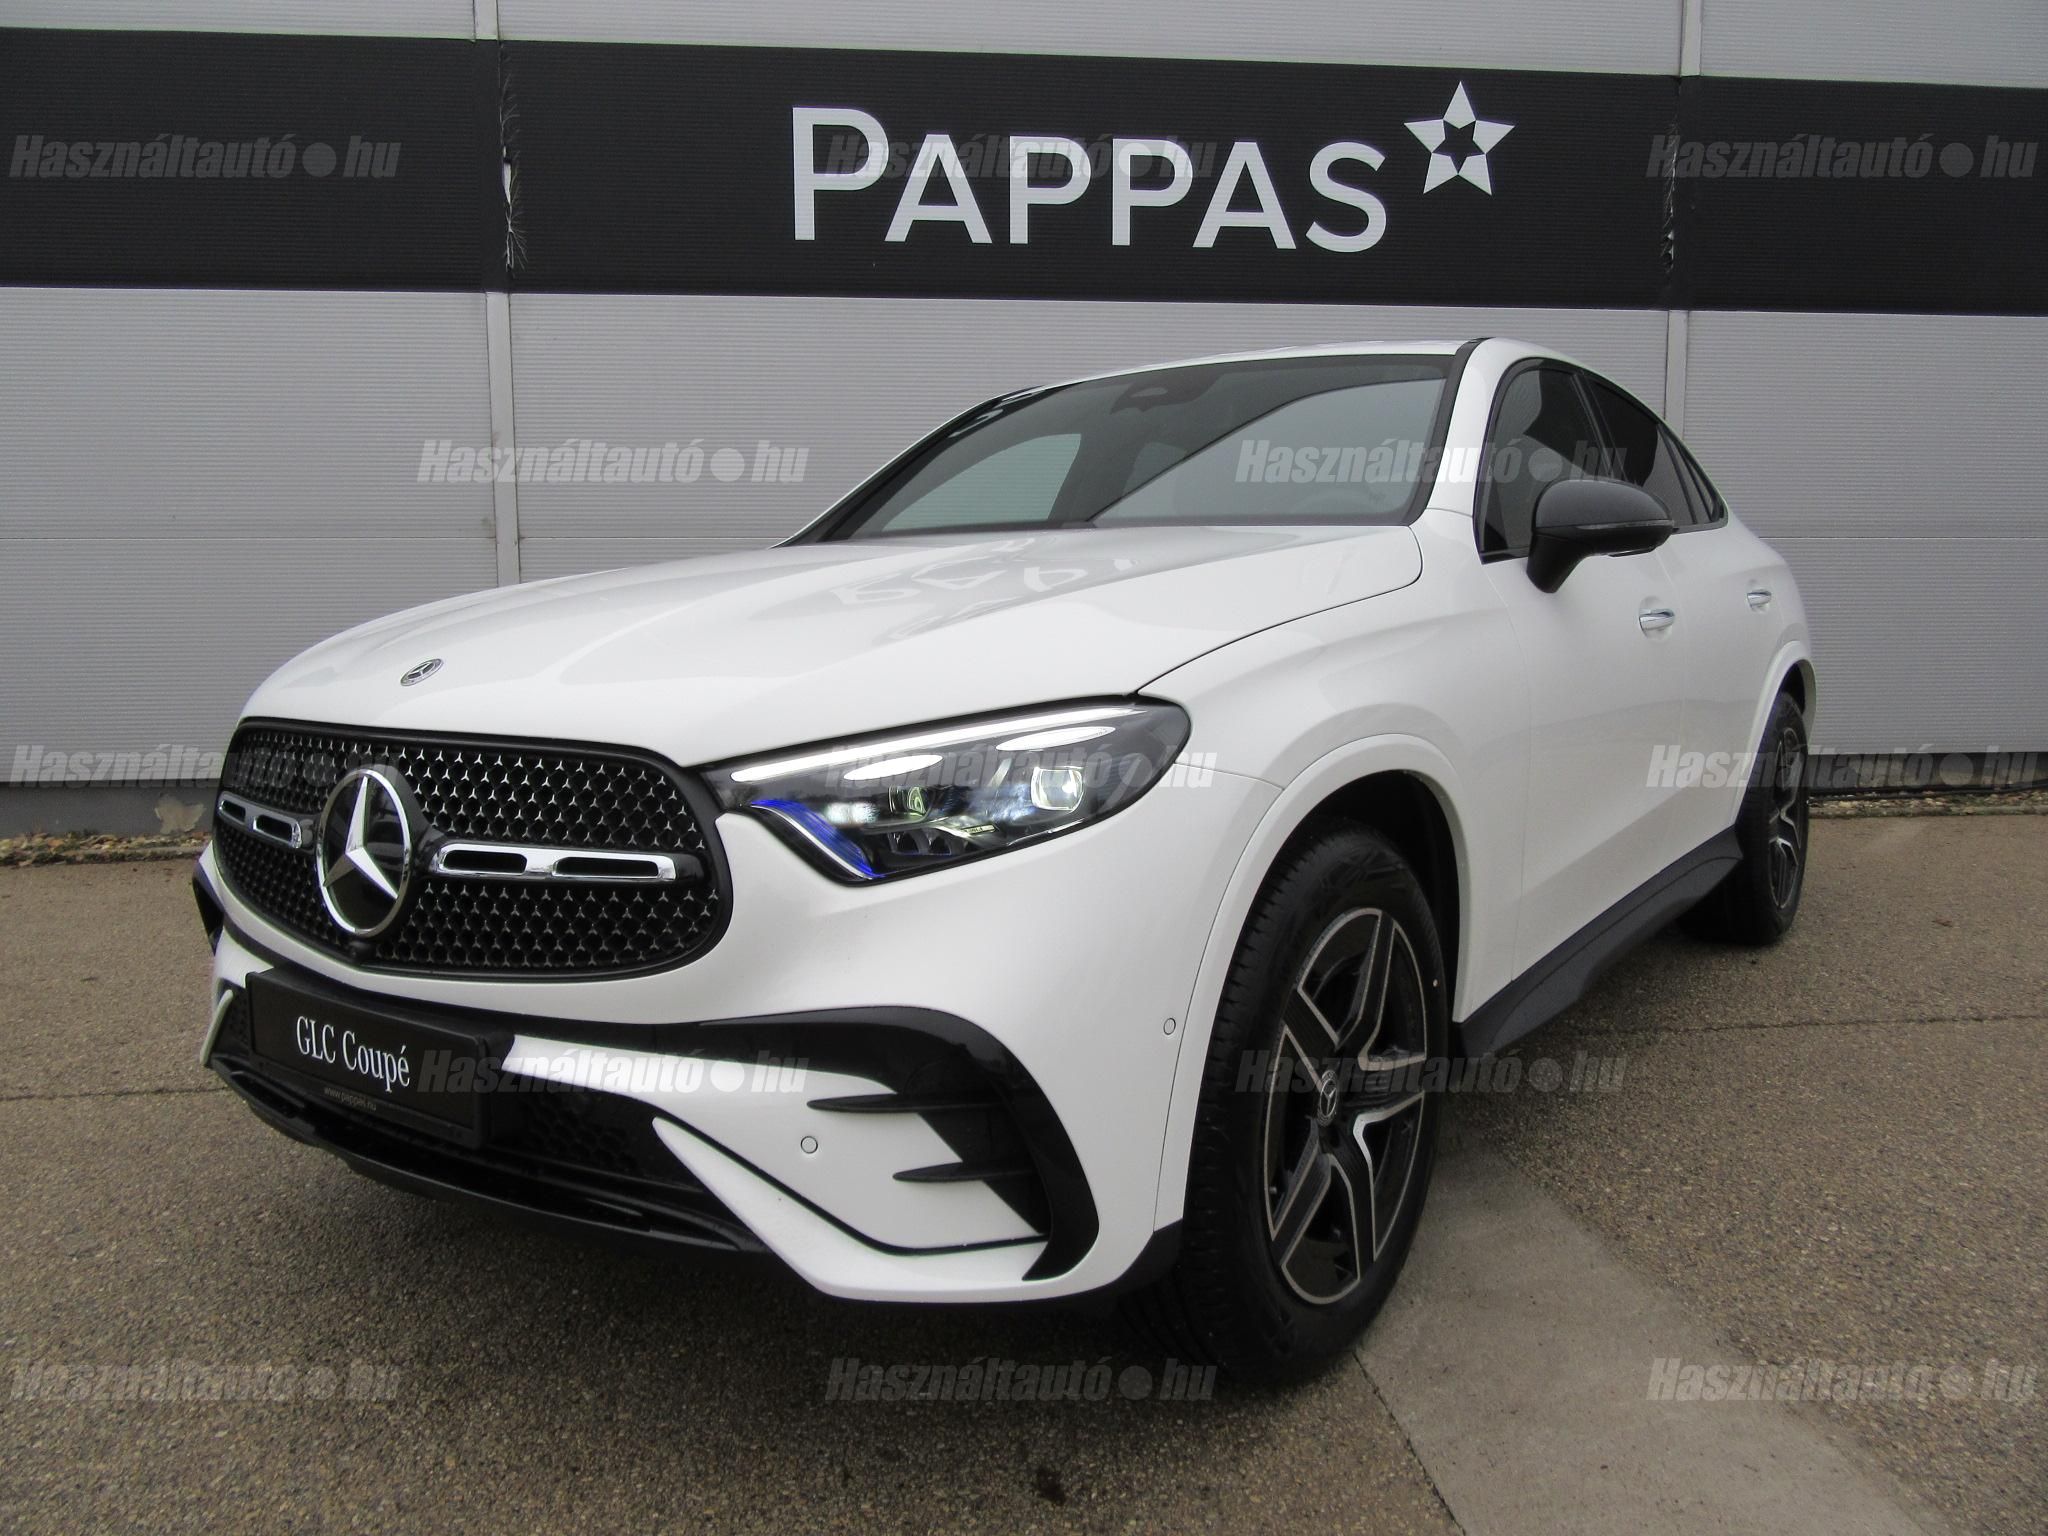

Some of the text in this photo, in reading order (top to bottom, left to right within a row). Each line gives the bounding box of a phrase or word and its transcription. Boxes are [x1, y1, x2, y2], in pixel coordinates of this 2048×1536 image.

[792, 106, 1388, 254] PAPPAS
[296, 1015, 411, 1093] GLC Coupé
